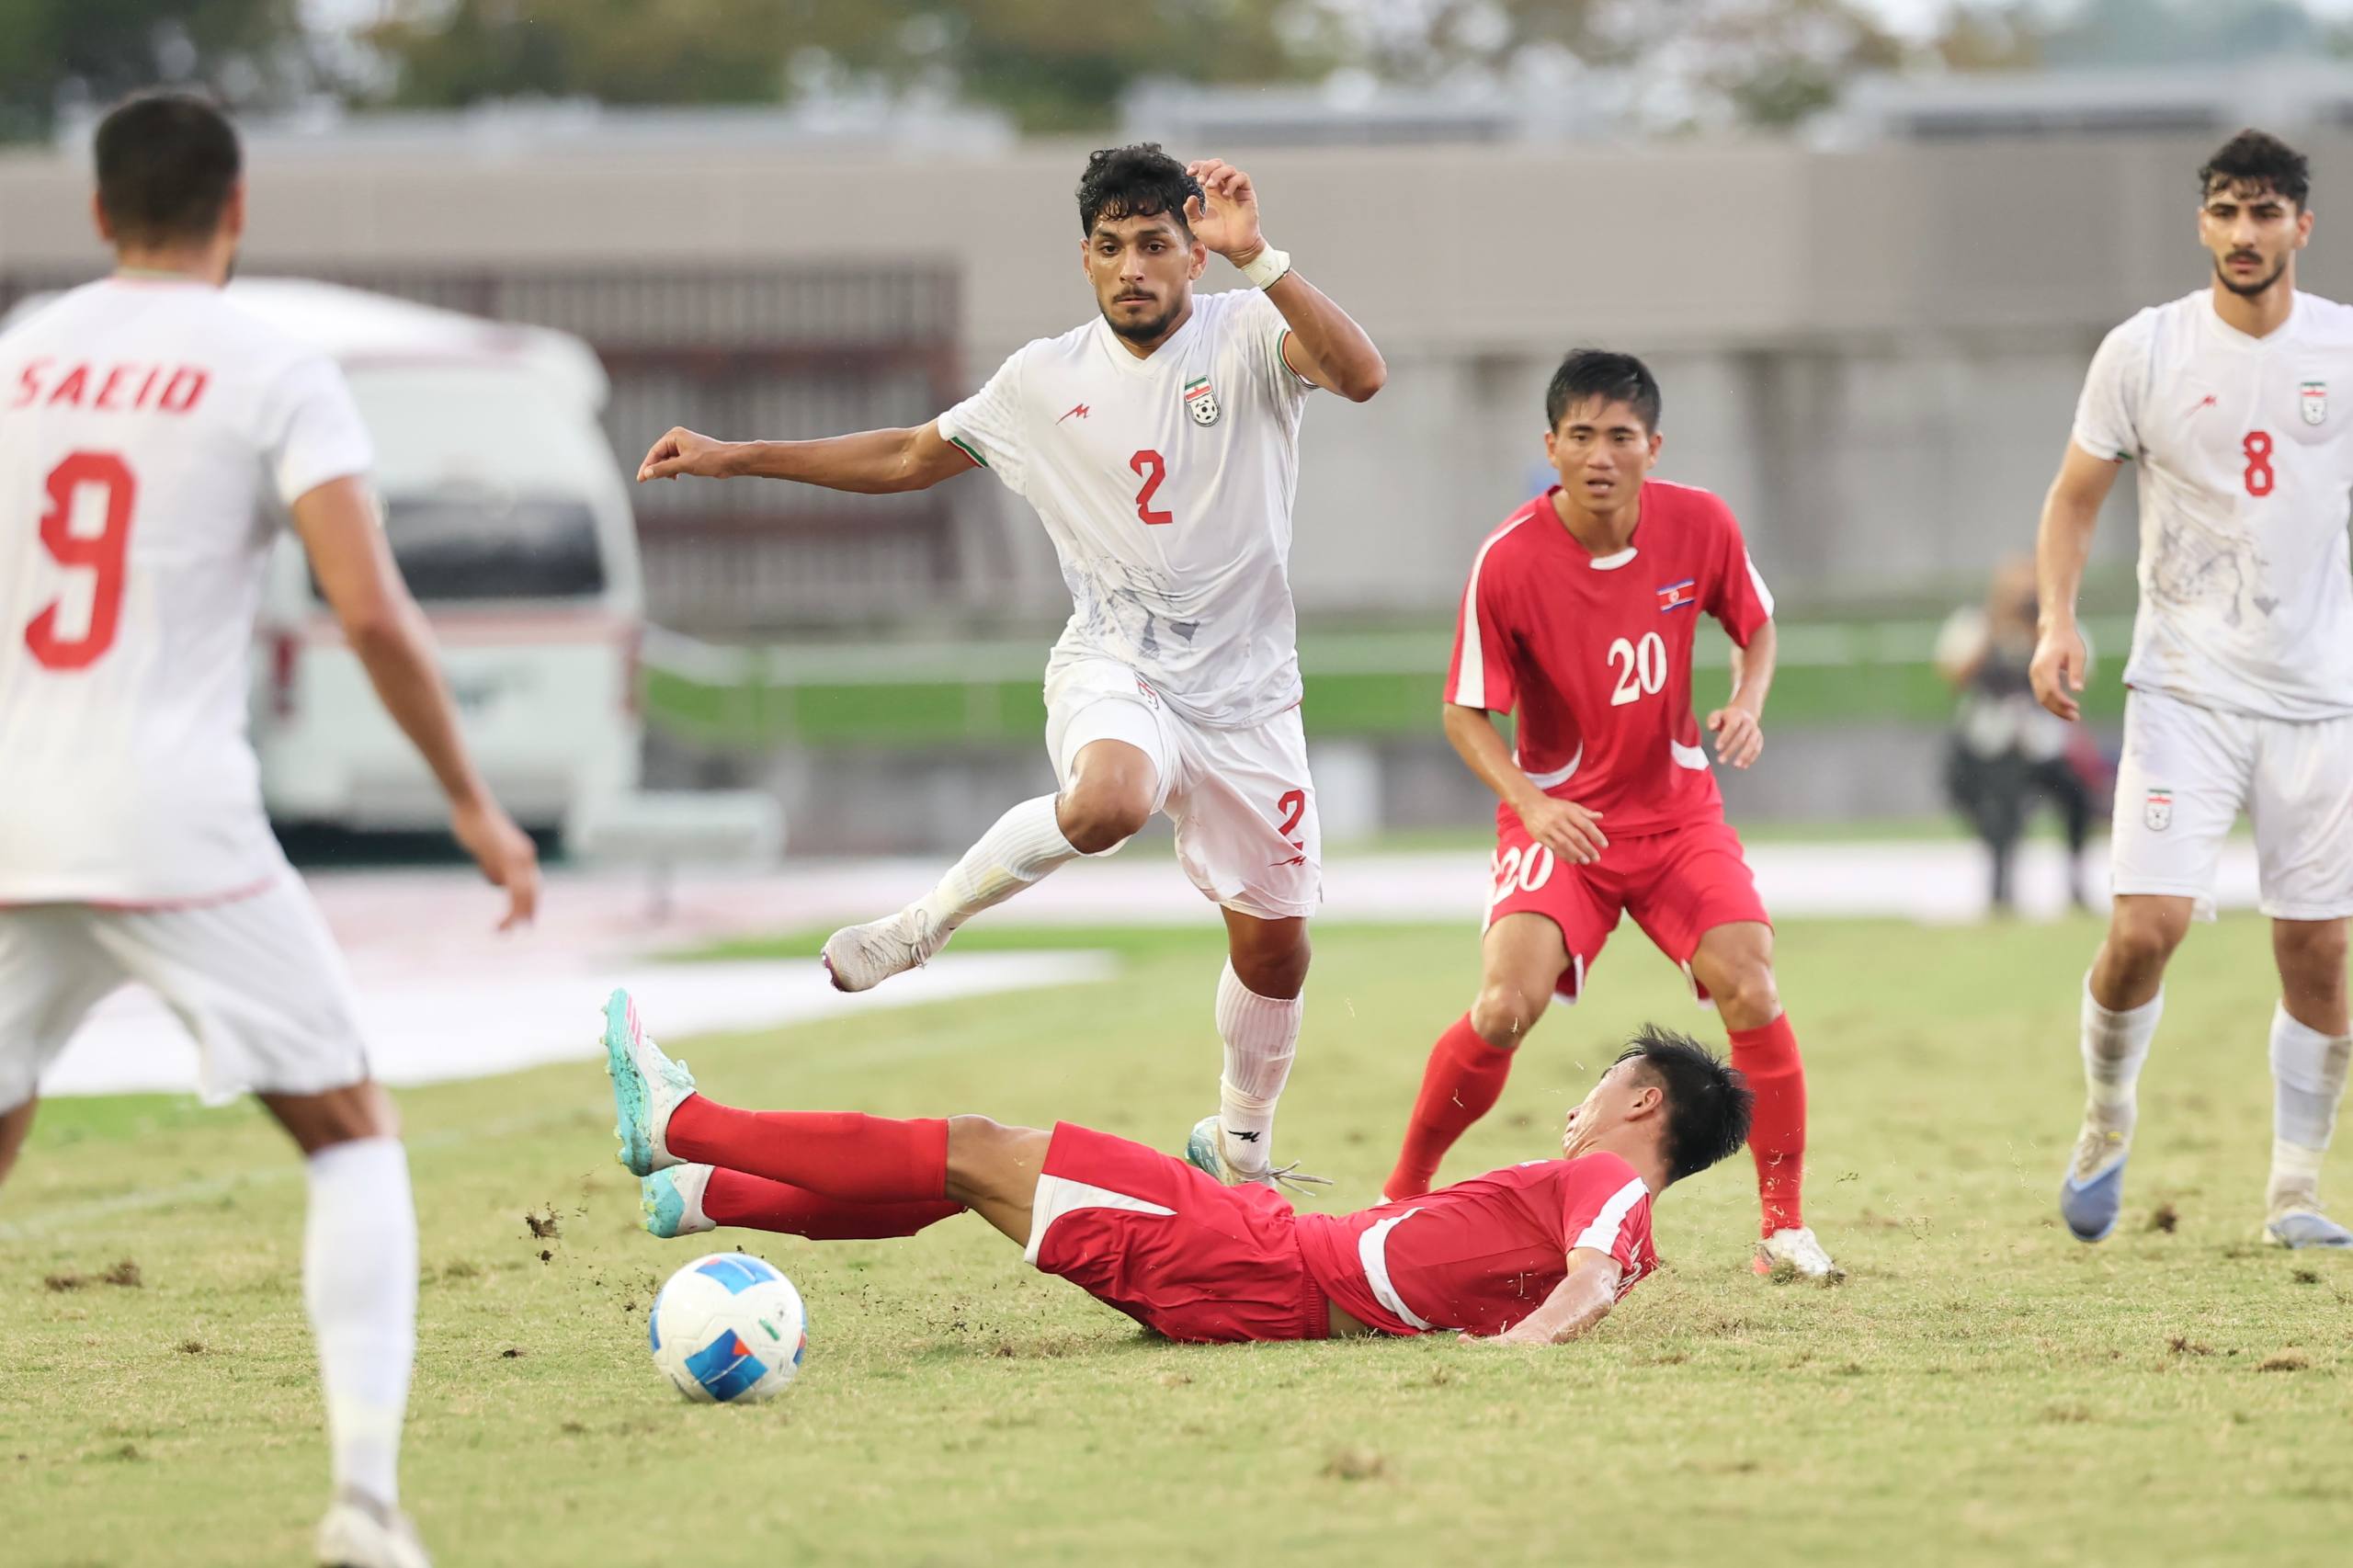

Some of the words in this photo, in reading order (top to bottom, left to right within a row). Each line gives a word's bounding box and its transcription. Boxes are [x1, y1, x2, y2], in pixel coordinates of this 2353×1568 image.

[13, 359, 210, 415] SAEID
[1129, 449, 1173, 525] 2
[2243, 429, 2275, 497] 8
[24, 450, 139, 673] 9
[1608, 631, 1667, 707] 20
[1279, 790, 1305, 852] 2
[1491, 841, 1554, 907] 20
